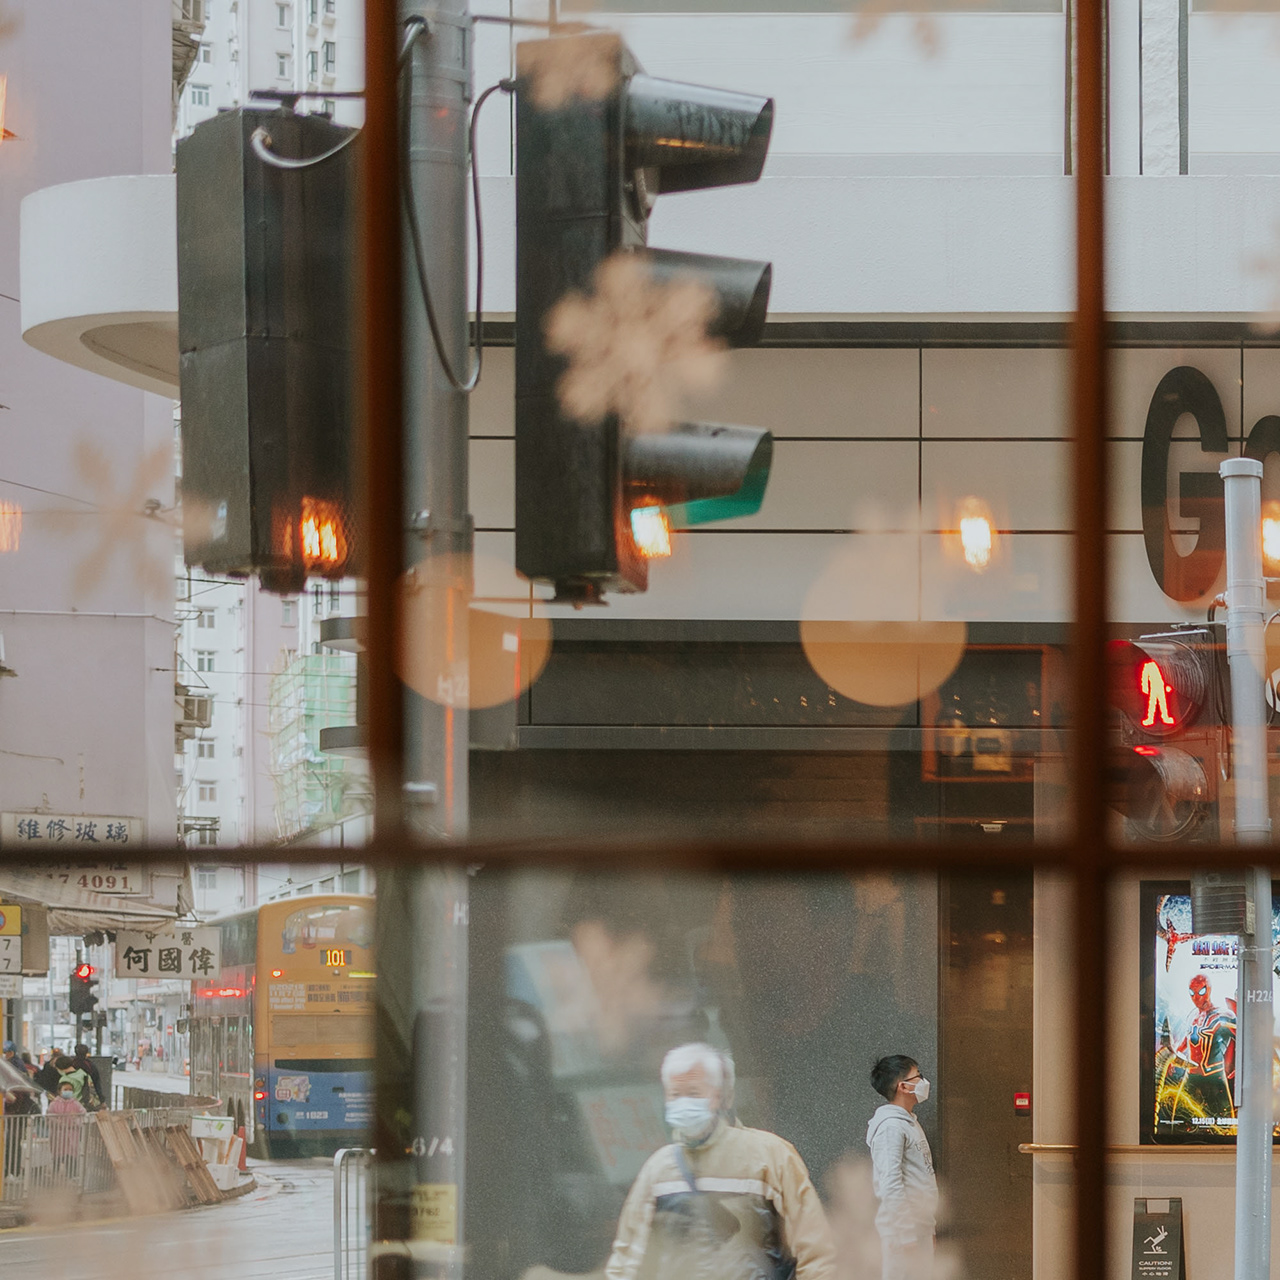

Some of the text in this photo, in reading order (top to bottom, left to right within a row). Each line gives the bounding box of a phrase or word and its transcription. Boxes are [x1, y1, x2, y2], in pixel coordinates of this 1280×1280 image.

[17, 819, 128, 843] 維修玻璃
[77, 875, 129, 889] 4091
[123, 946, 216, 976] 何國偉
[326, 950, 346, 967] 101
